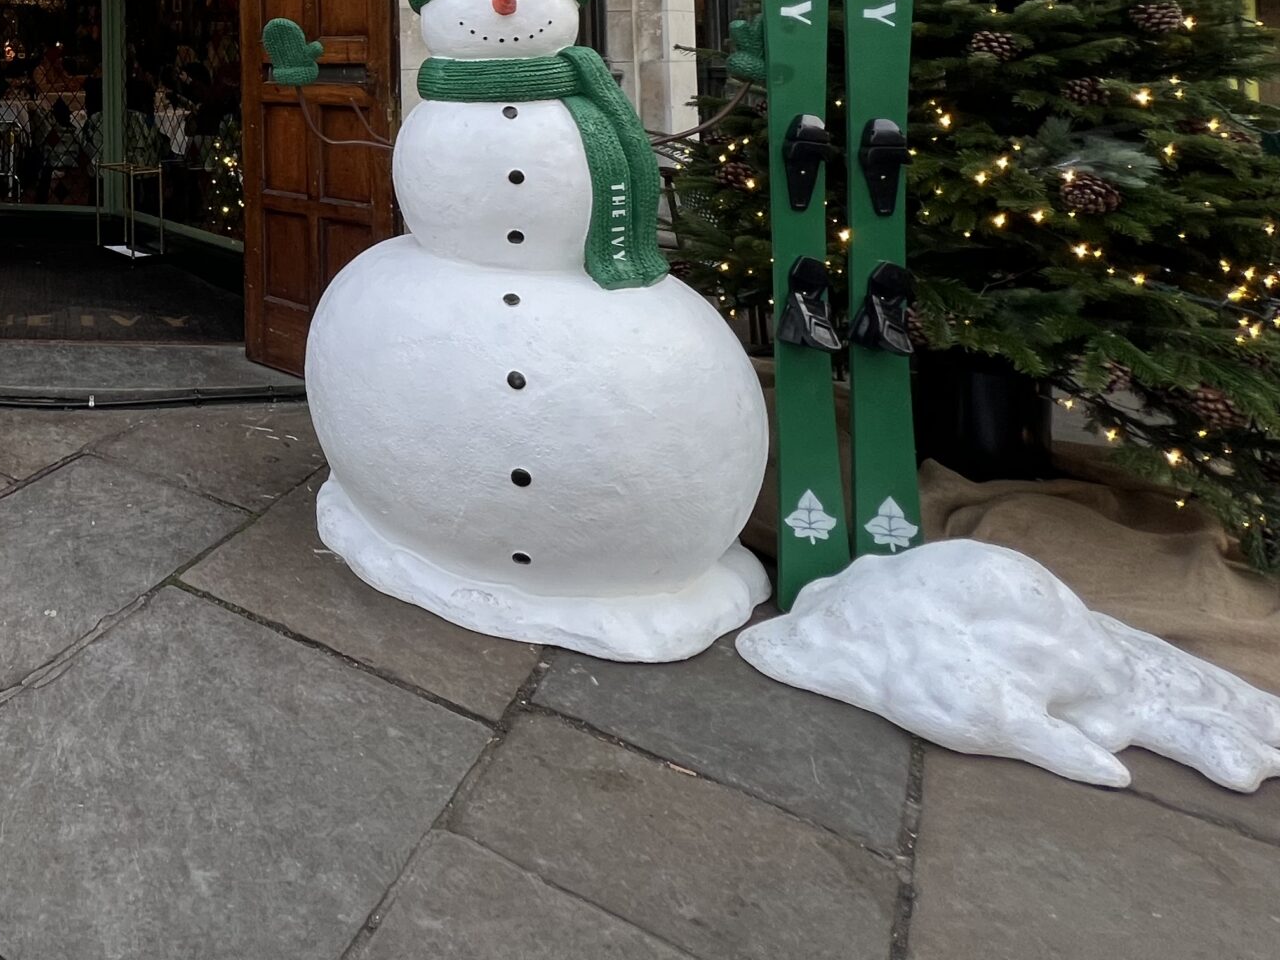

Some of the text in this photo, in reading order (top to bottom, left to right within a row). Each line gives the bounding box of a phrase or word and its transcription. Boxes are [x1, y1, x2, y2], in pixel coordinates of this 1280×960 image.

[610, 182, 626, 261] THE IVY
[80, 313, 191, 328] IVY
